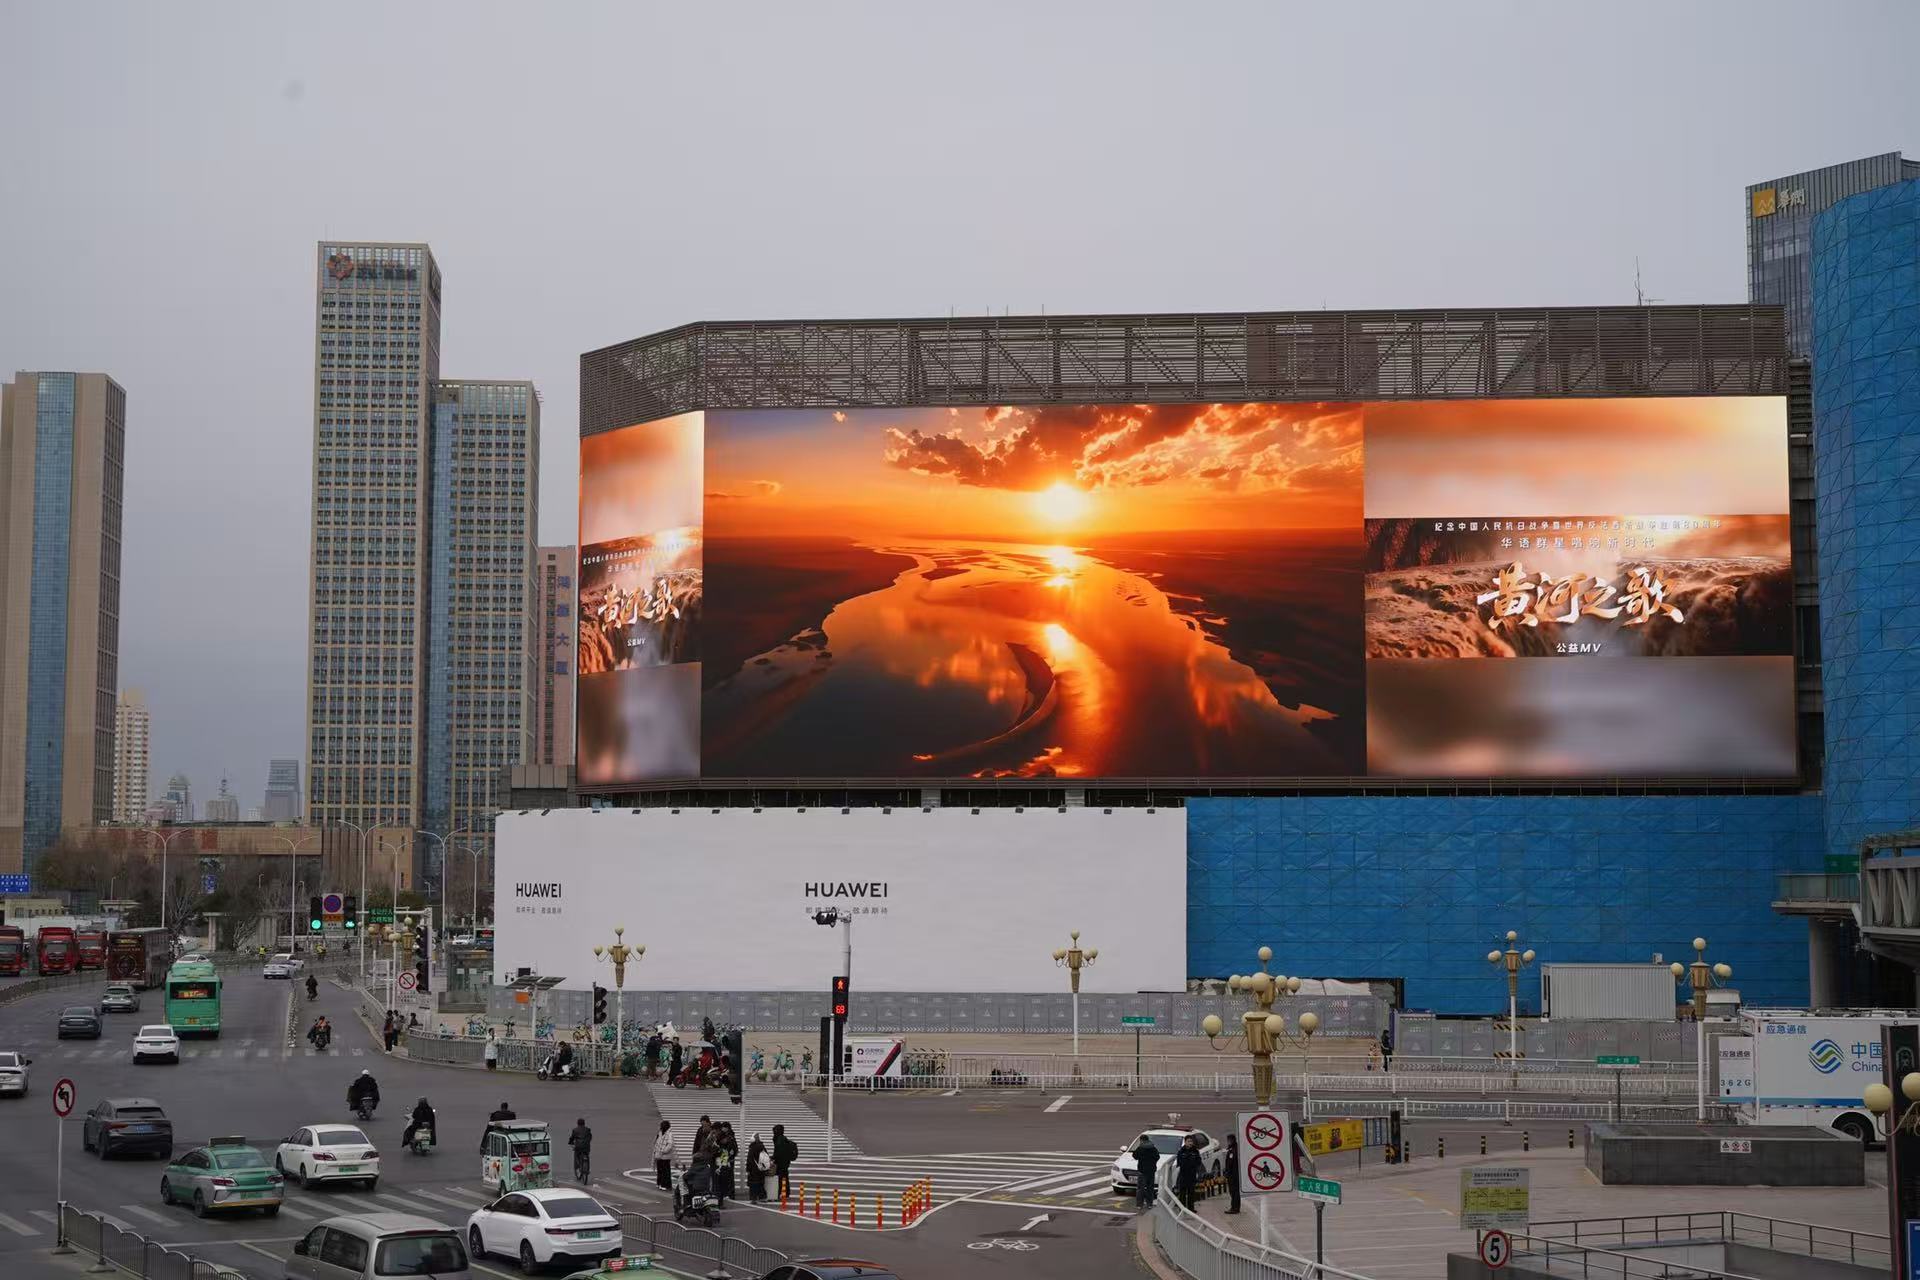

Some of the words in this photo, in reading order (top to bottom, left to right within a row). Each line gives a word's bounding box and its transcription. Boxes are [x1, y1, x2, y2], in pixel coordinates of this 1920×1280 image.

[1500, 537, 1655, 549] 华语群星唱响新时代
[1477, 560, 1686, 629] 黄河之歌
[1556, 642, 1602, 654] 公益MV
[516, 883, 562, 898] HUAWEI
[805, 882, 888, 898] HUAWEI
[1766, 1024, 1808, 1035] 应急通信
[1489, 1237, 1500, 1263] 5
